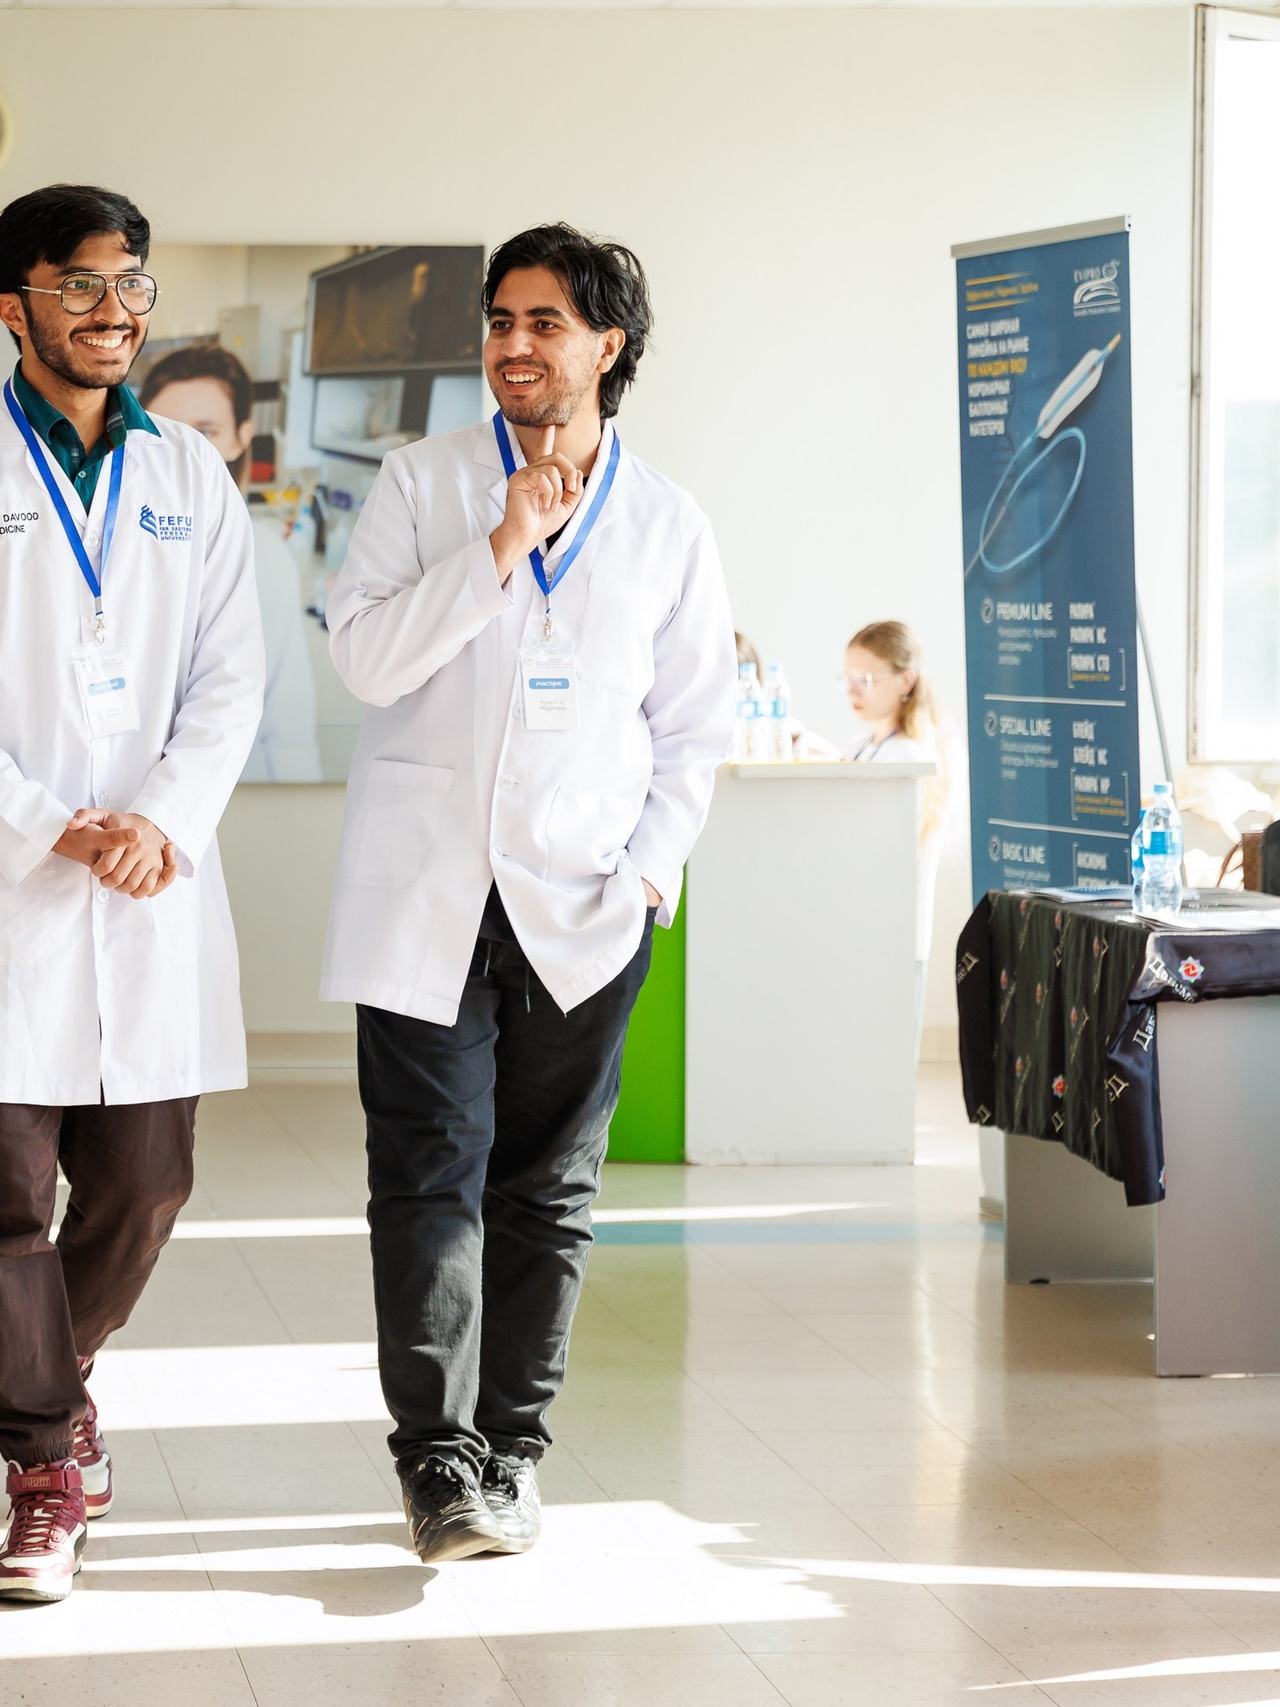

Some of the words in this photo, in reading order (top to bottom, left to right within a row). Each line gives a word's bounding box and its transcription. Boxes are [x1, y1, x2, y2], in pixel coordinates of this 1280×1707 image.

[3, 512, 39, 522] DAVOOD
[158, 516, 192, 526] FEFU
[996, 601, 1030, 620] PREMIUM
[1031, 602, 1053, 620] LINE
[1000, 715, 1029, 736] SPECIAL
[1030, 718, 1052, 737] LINE
[1002, 841, 1024, 862] BASIC
[1024, 844, 1046, 864] LINE
[22, 1476, 51, 1488] PUMA
